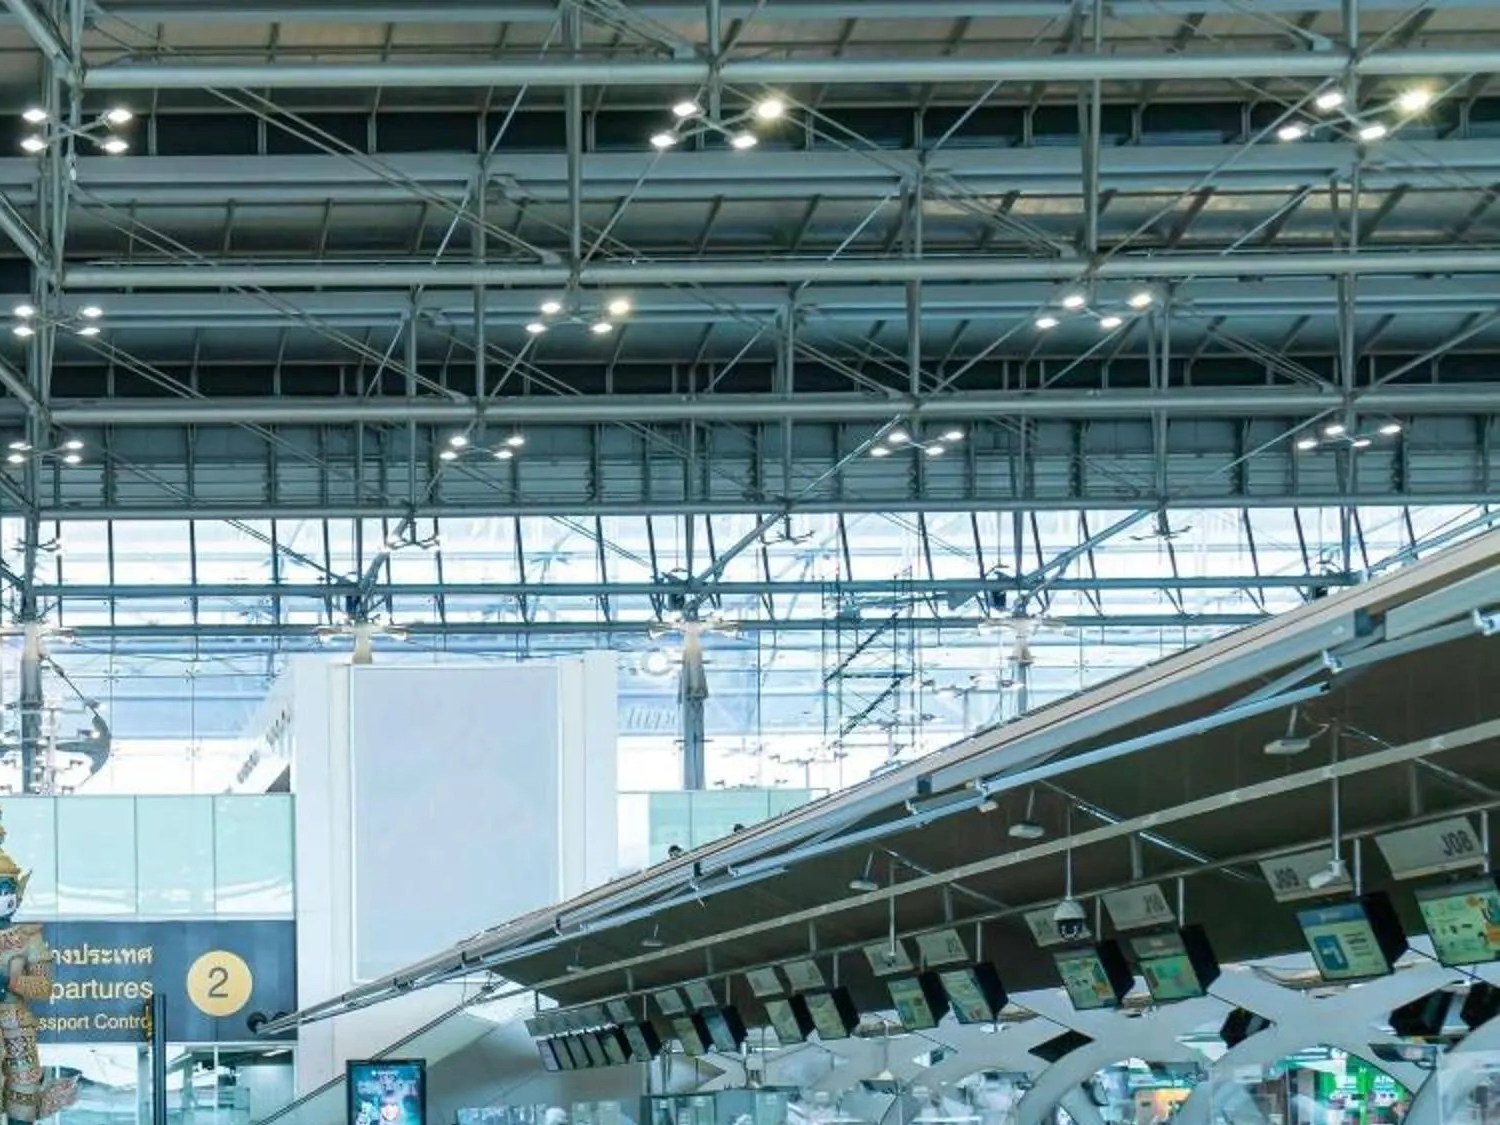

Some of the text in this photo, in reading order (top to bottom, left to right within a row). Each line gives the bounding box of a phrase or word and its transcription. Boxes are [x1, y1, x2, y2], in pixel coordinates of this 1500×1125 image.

[49, 979, 153, 1004] partures
[207, 966, 229, 999] 2
[37, 1014, 90, 1033] ssport
